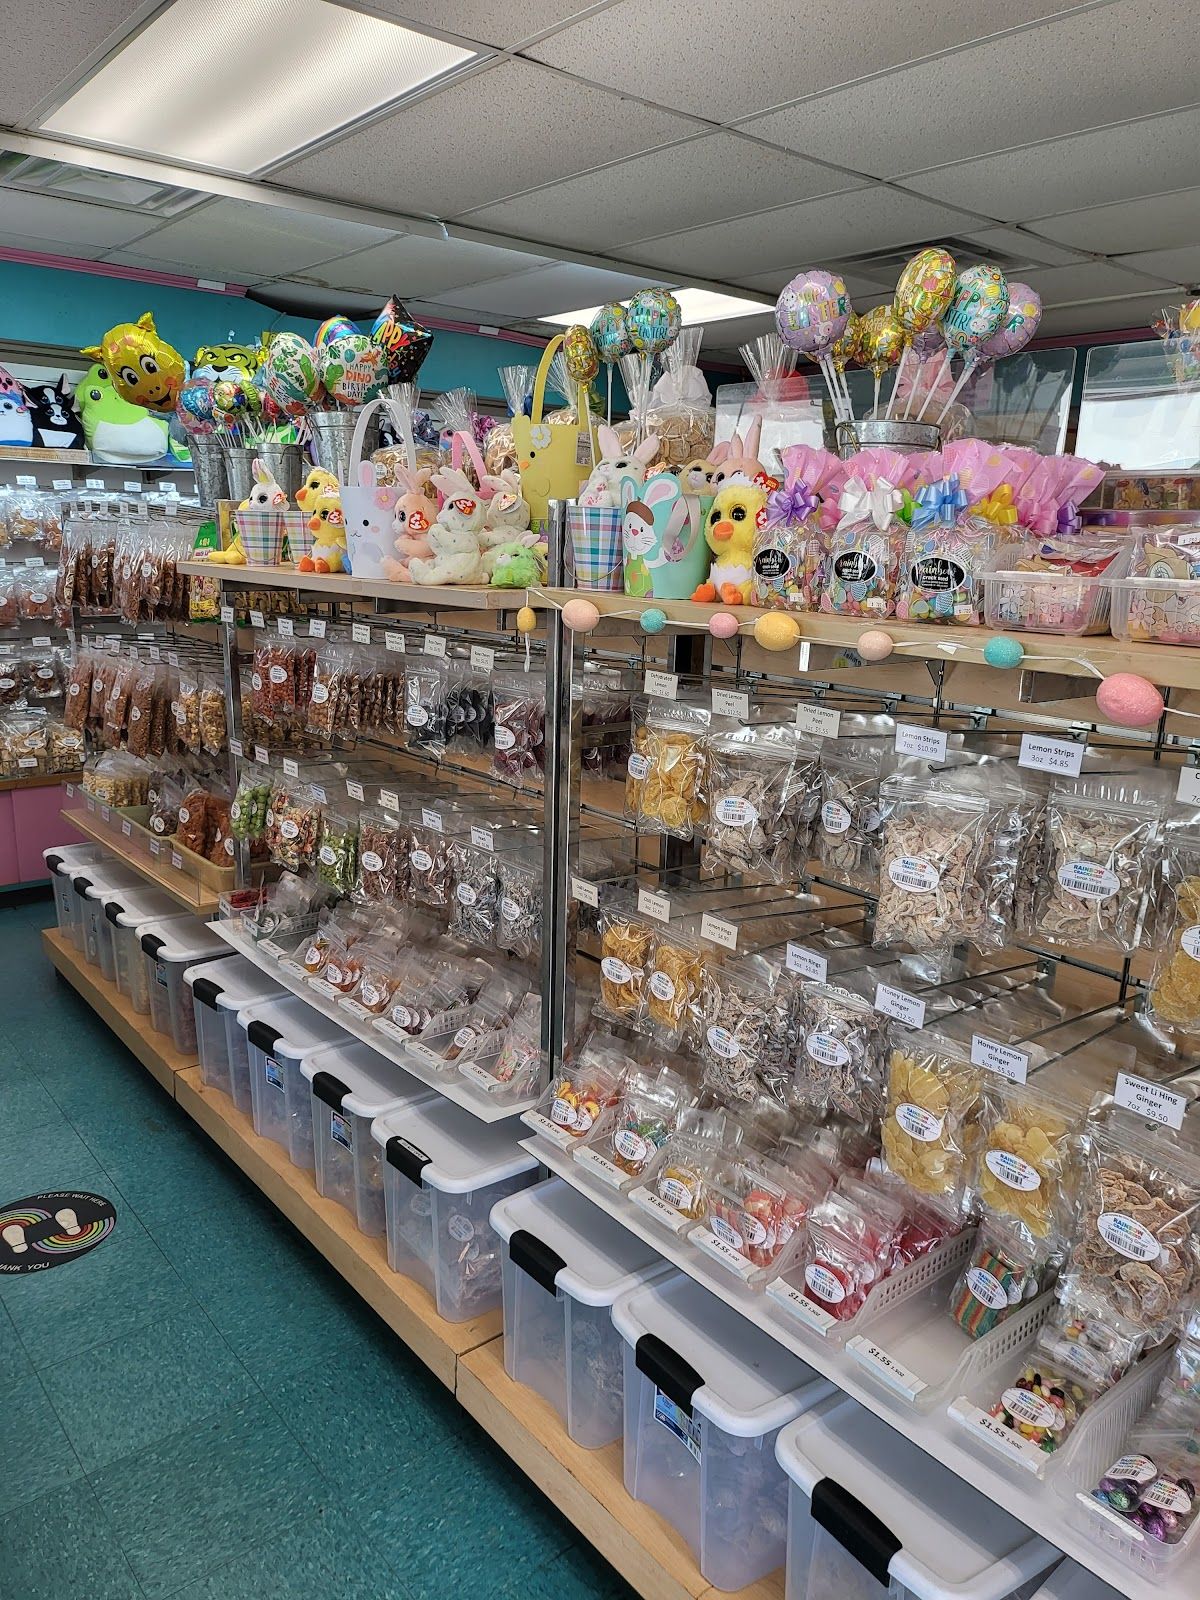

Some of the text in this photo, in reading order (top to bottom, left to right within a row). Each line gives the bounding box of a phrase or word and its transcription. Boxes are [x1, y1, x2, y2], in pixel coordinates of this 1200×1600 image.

[372, 320, 410, 352] APPY
[346, 370, 372, 383] DINO
[347, 390, 364, 399] DAY!
[804, 706, 834, 718] Dried Lemon
[902, 731, 940, 745] Lemon Strips
[903, 741, 938, 754] 7oz $10.99
[1028, 743, 1075, 758] Lemon Strips
[1031, 754, 1069, 768] 3oz $4.85
[1073, 864, 1105, 875] RAINBOW
[707, 921, 732, 936] Lemon Rings
[791, 951, 821, 969] Lemon Rings
[882, 986, 921, 1008] Honey Lemon
[890, 1000, 910, 1012] Ginger
[882, 1005, 915, 1024] 7oz $12.50
[978, 1039, 1022, 1062] Honey Lemon
[987, 1053, 1010, 1067] Ginger
[981, 1059, 1015, 1078] 3oz $5.50
[1124, 1078, 1178, 1106] Sweet Li Hing
[1136, 1094, 1163, 1109] Ginger
[1127, 1100, 1168, 1123] 7oz $9.50
[90, 1198, 107, 1207] HERE
[647, 1196, 665, 1209] $1.55
[711, 1240, 729, 1254] $1.55
[27, 1262, 50, 1271] YOU
[788, 1291, 809, 1308] $1.55
[868, 1347, 892, 1366] $1.55
[980, 1418, 1006, 1438] $1.55
